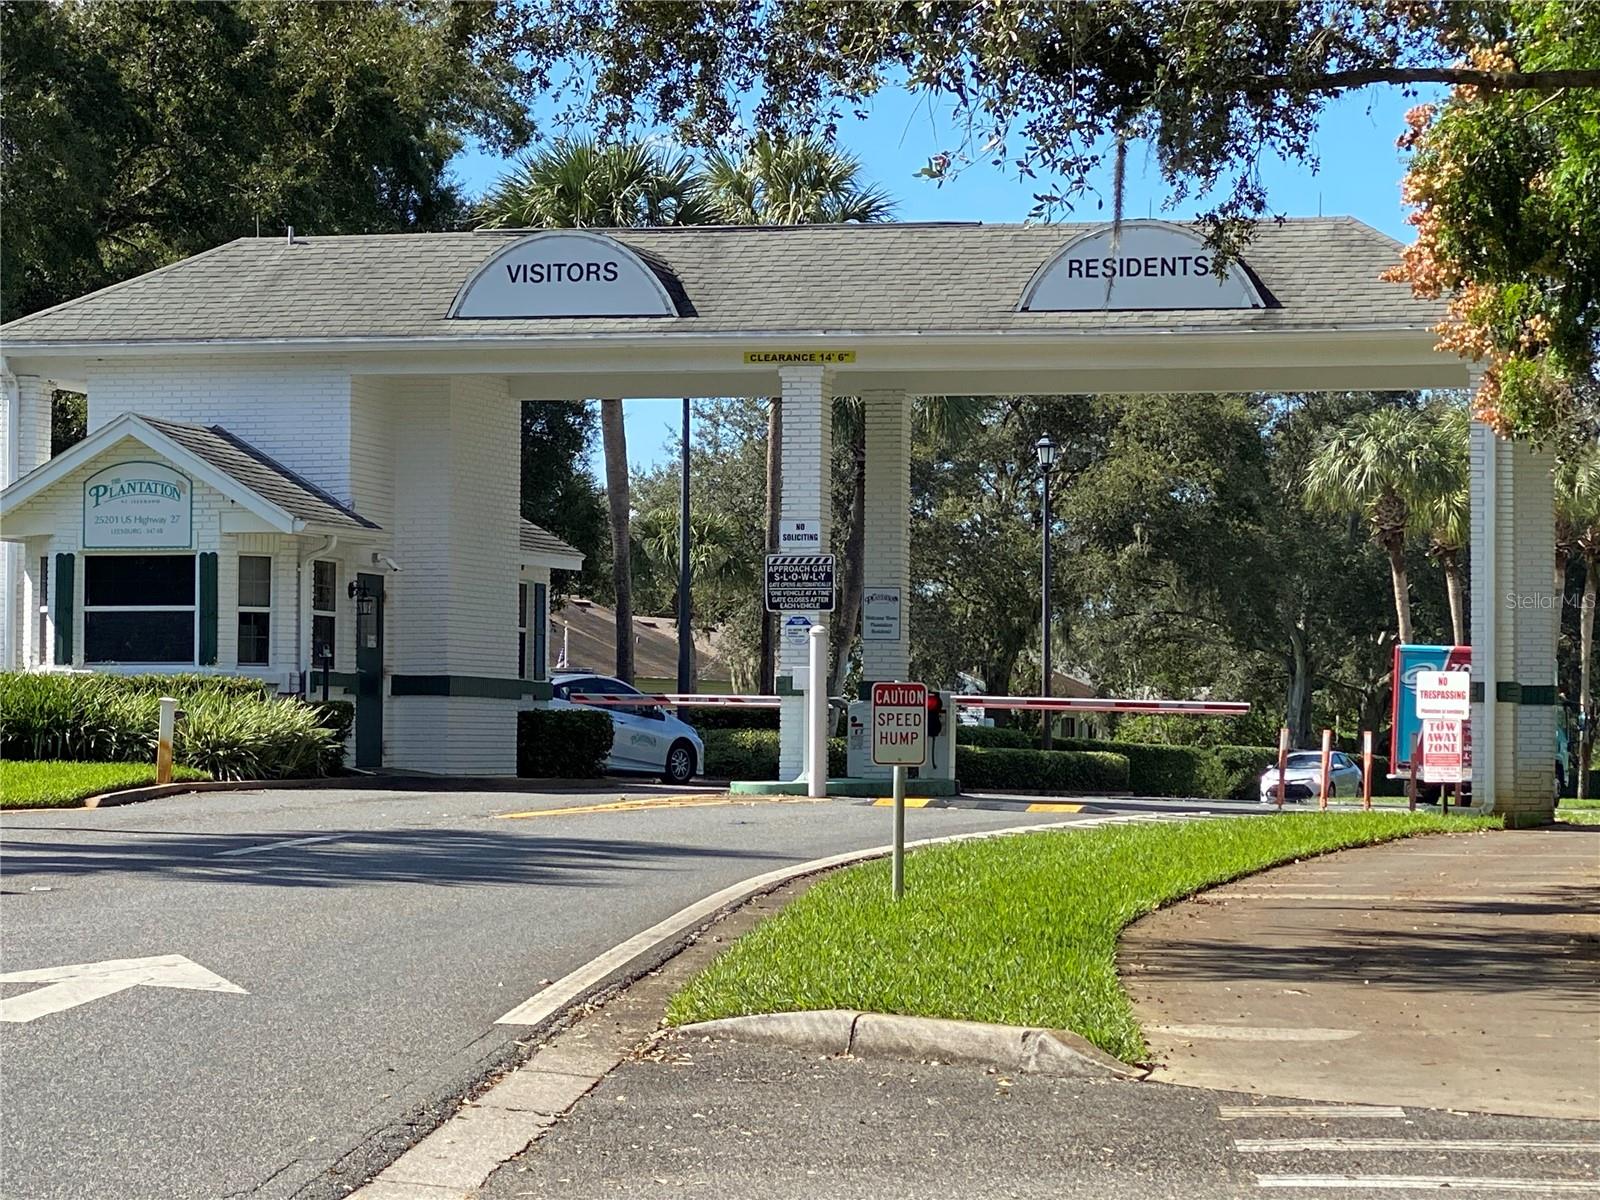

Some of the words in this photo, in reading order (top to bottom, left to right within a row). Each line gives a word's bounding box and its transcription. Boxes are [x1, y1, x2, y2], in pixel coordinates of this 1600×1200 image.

[1068, 256, 1210, 278] RESIDENTS
[506, 262, 618, 283] VISITORS
[819, 353, 834, 361] 14'
[88, 481, 181, 508] PLANTATION
[94, 516, 118, 525] 25201
[121, 516, 132, 524] US
[134, 516, 166, 526] Highway
[170, 515, 181, 523] 27
[795, 523, 806, 531] NO
[1438, 677, 1448, 685] NO
[875, 690, 924, 704] CAUTION
[1420, 690, 1466, 700] TRESPASSING
[878, 713, 921, 726] SPEED
[1429, 722, 1457, 731] TOW
[880, 732, 919, 745] HUMP
[1427, 733, 1457, 742] AWAY
[1428, 744, 1457, 752] ZONE
